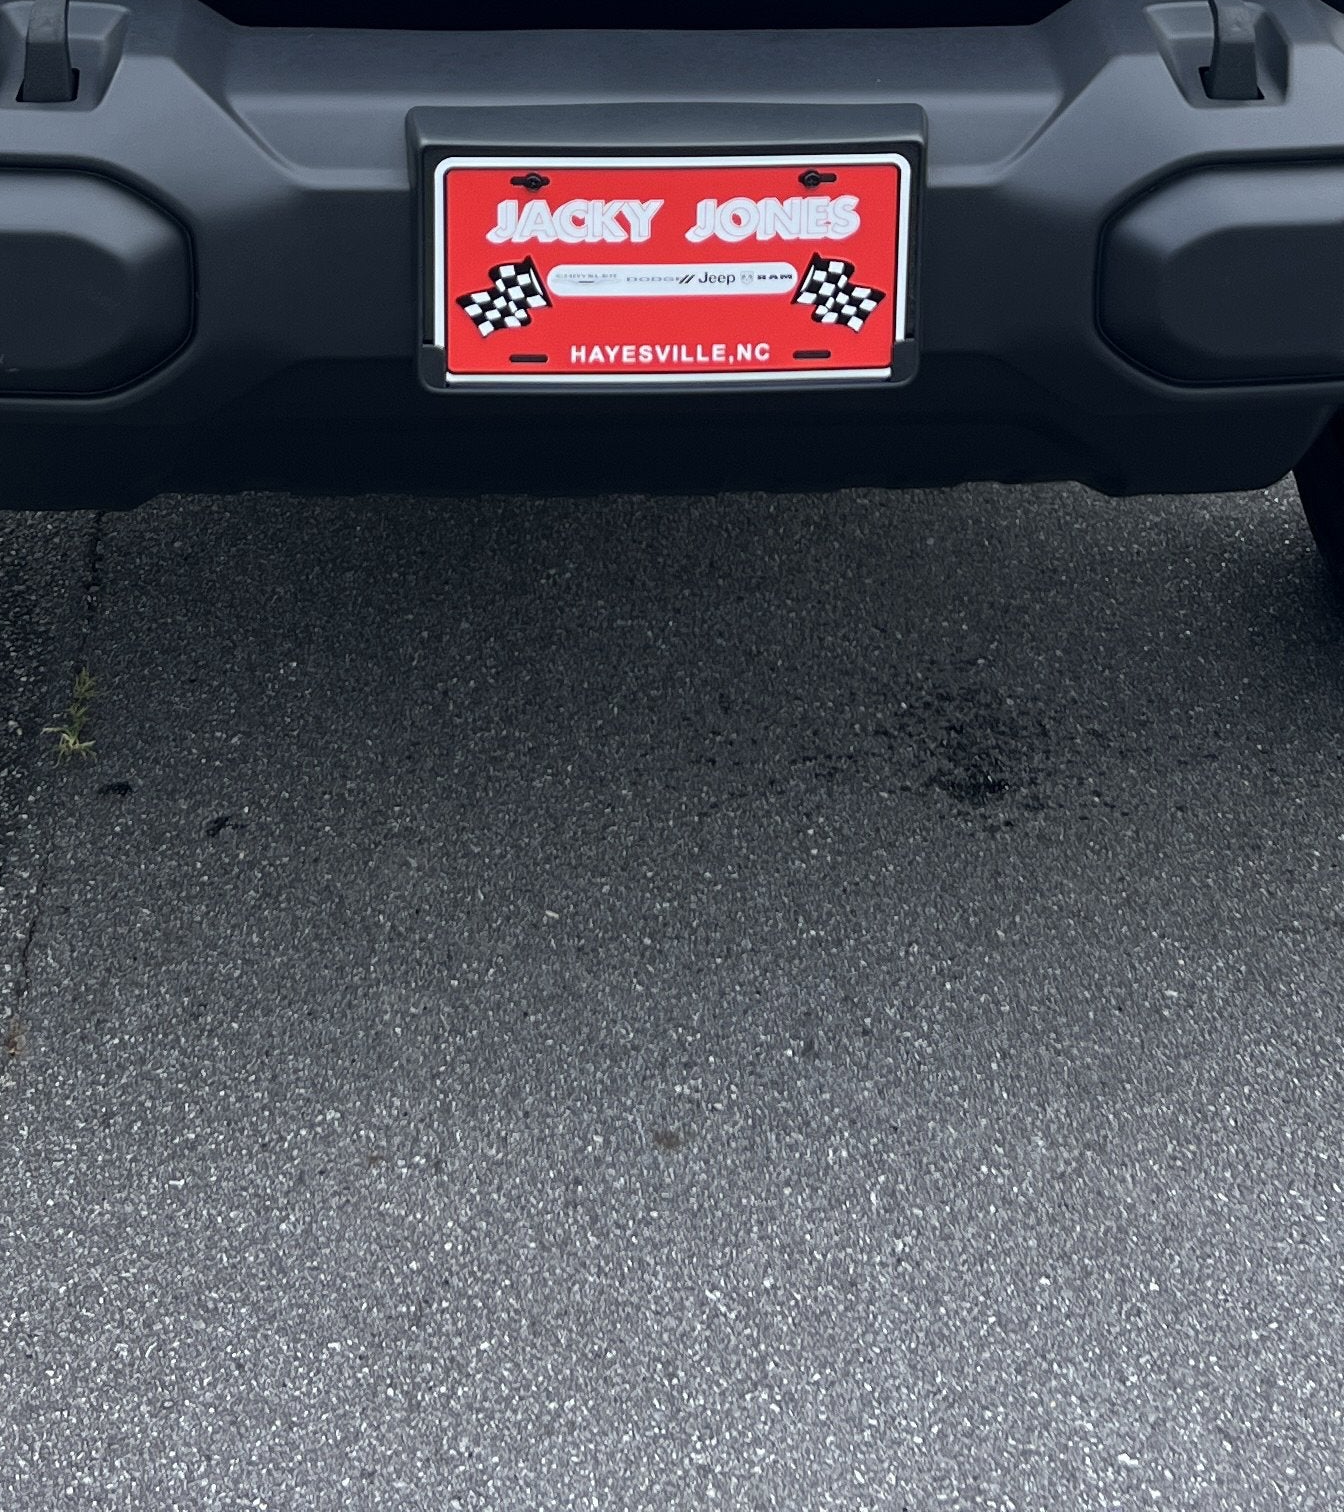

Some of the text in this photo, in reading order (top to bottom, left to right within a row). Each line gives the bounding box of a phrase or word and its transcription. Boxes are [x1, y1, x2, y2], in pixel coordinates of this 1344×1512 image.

[486, 195, 860, 243] JACKY JONES
[698, 271, 736, 285] Jeep
